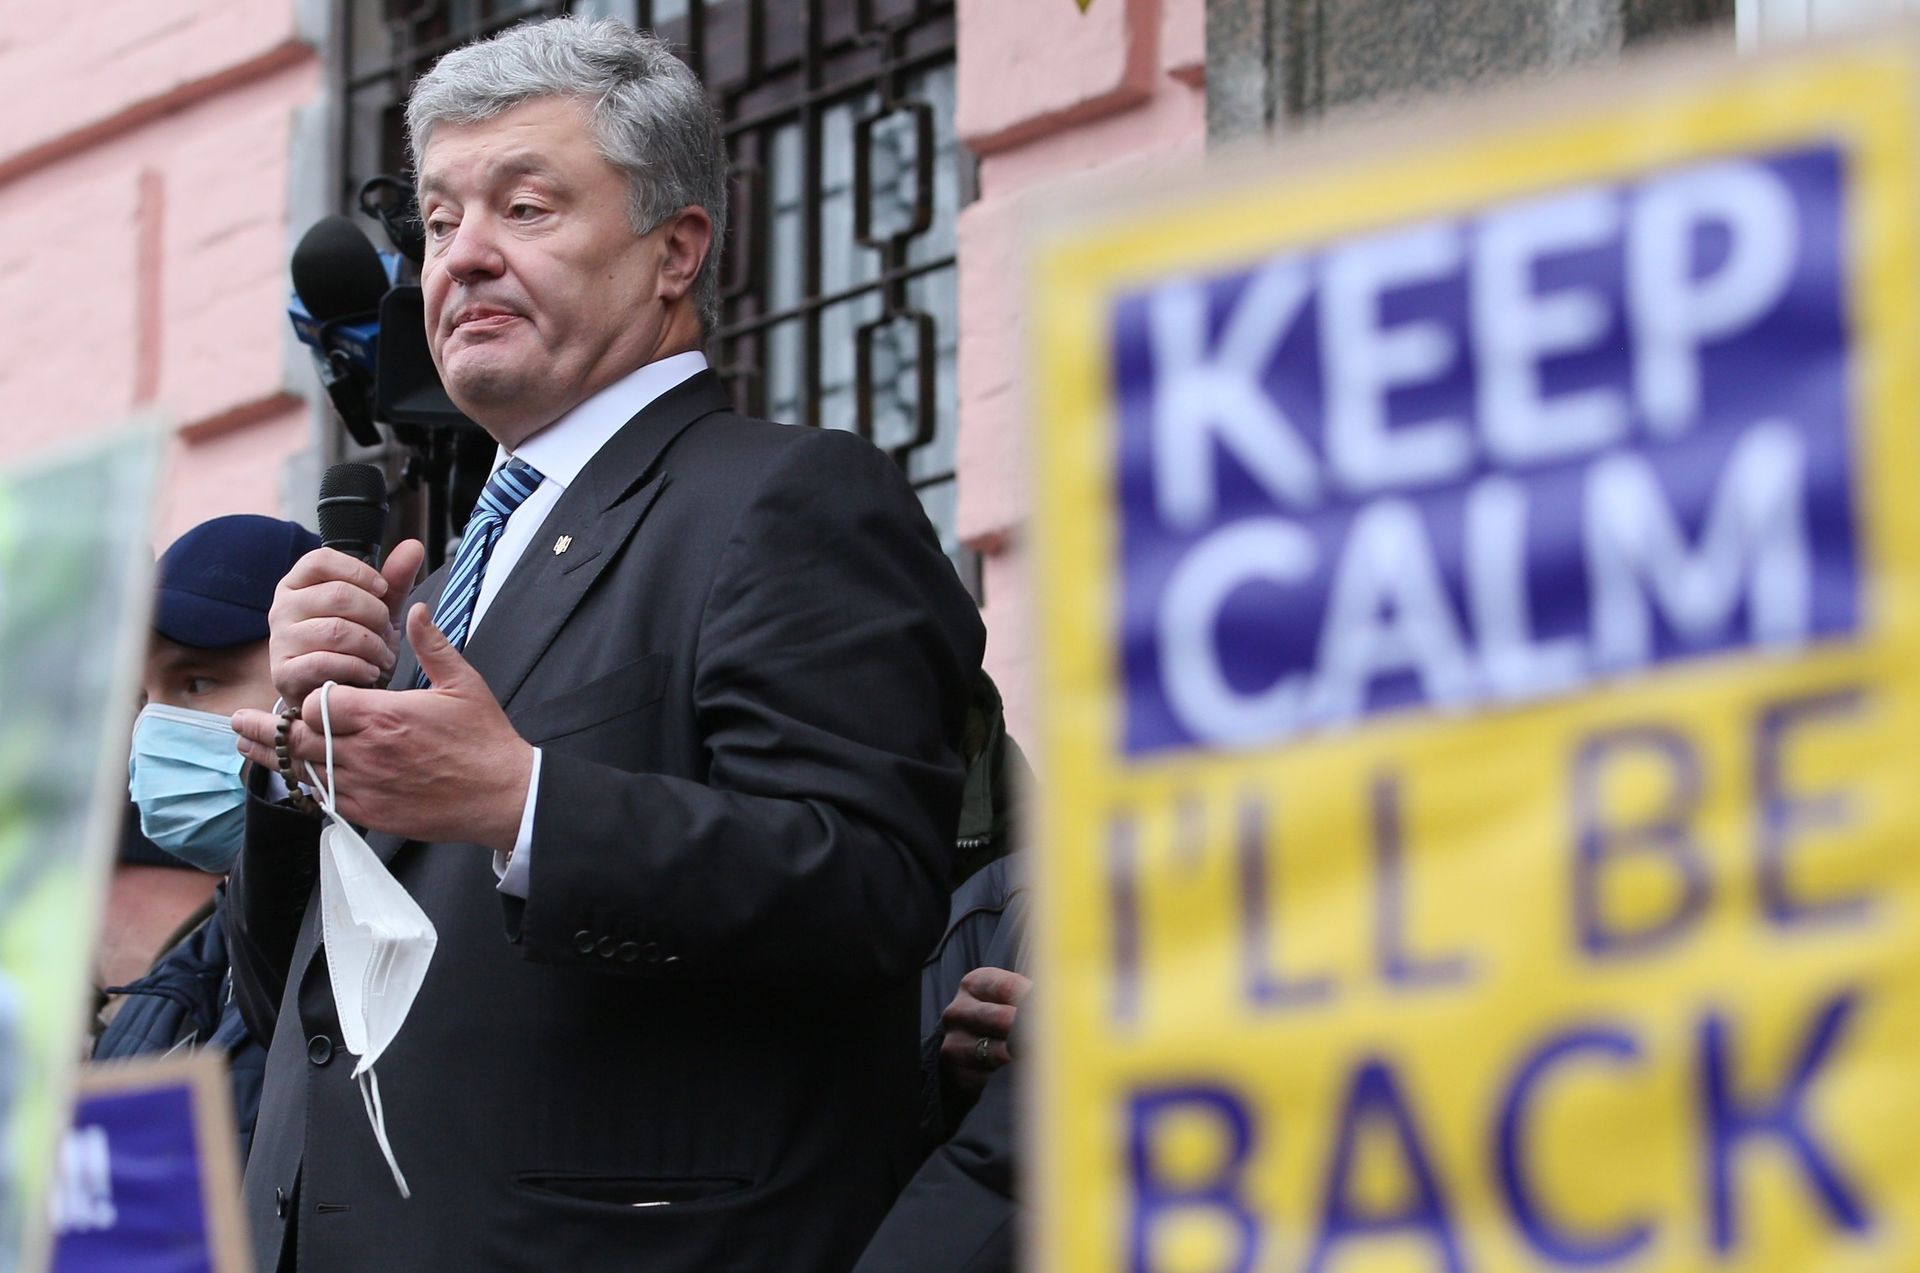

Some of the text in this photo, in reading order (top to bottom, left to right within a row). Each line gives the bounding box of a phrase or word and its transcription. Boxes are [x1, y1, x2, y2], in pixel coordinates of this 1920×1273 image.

[1150, 157, 1801, 530] KEEP
[1157, 416, 1812, 748] CALM
[1108, 682, 1880, 1033] I'LL BE
[1122, 987, 1874, 1273] BACK
